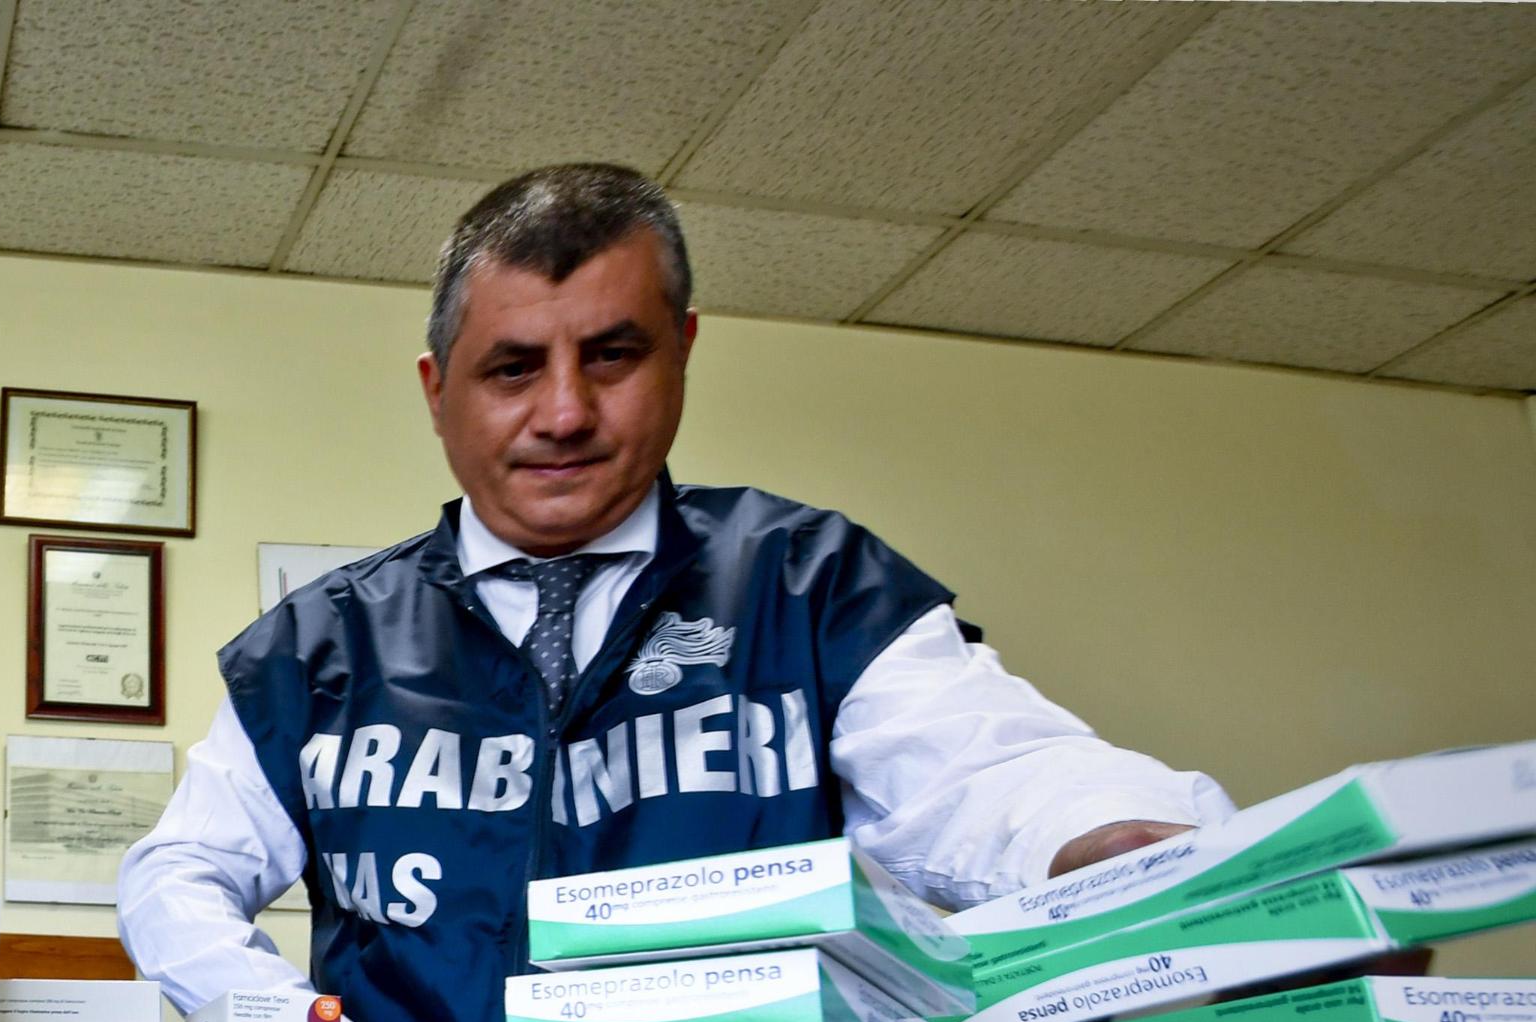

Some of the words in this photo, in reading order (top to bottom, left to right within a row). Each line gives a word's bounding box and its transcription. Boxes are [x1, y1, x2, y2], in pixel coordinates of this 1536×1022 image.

[556, 867, 724, 904] Esomeprazolo
[734, 857, 814, 886] pensa
[232, 993, 271, 1003] Famciclovir
[272, 996, 290, 1004] Teva
[531, 969, 695, 1001] Esomeprazolo
[705, 963, 782, 989] pensa
[1073, 964, 1208, 1012] Esomeprazolo
